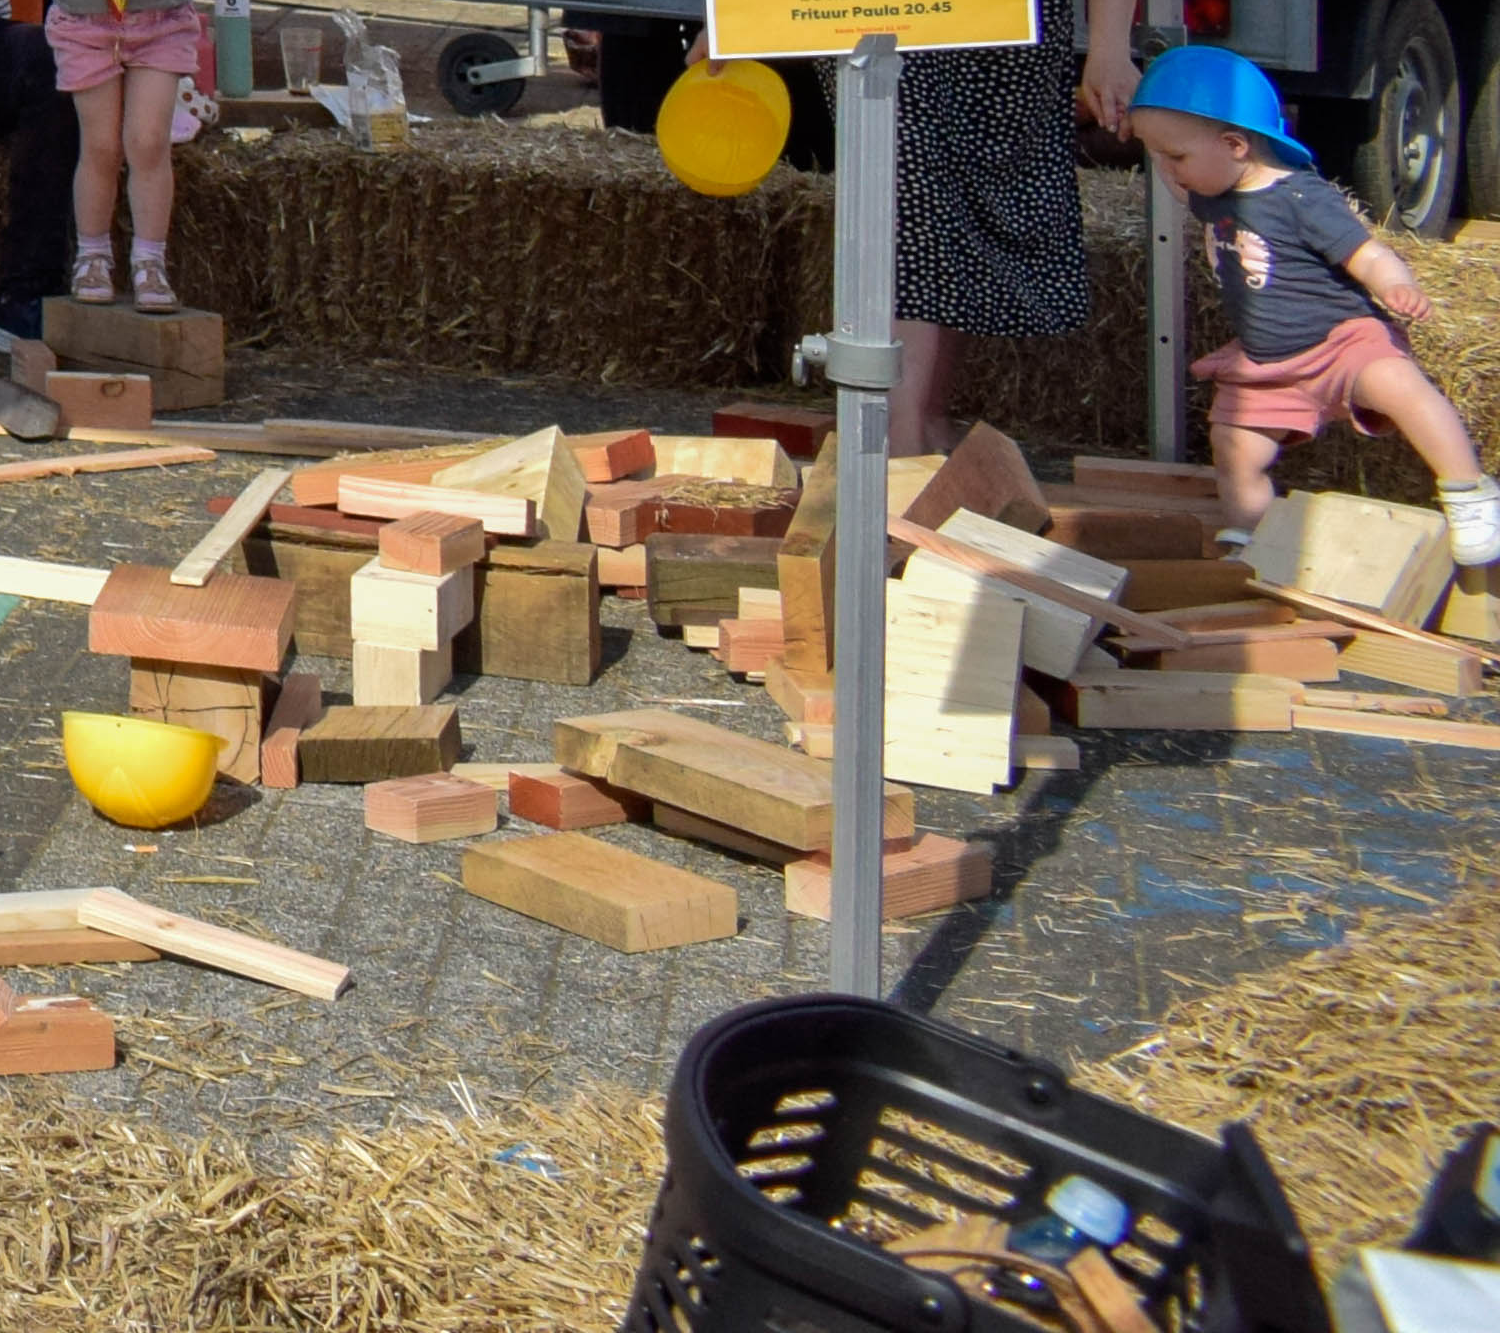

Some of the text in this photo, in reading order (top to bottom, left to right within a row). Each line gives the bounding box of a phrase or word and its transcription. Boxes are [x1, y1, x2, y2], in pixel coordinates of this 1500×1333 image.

[791, 1, 953, 20] Frituur Paula 20.45
